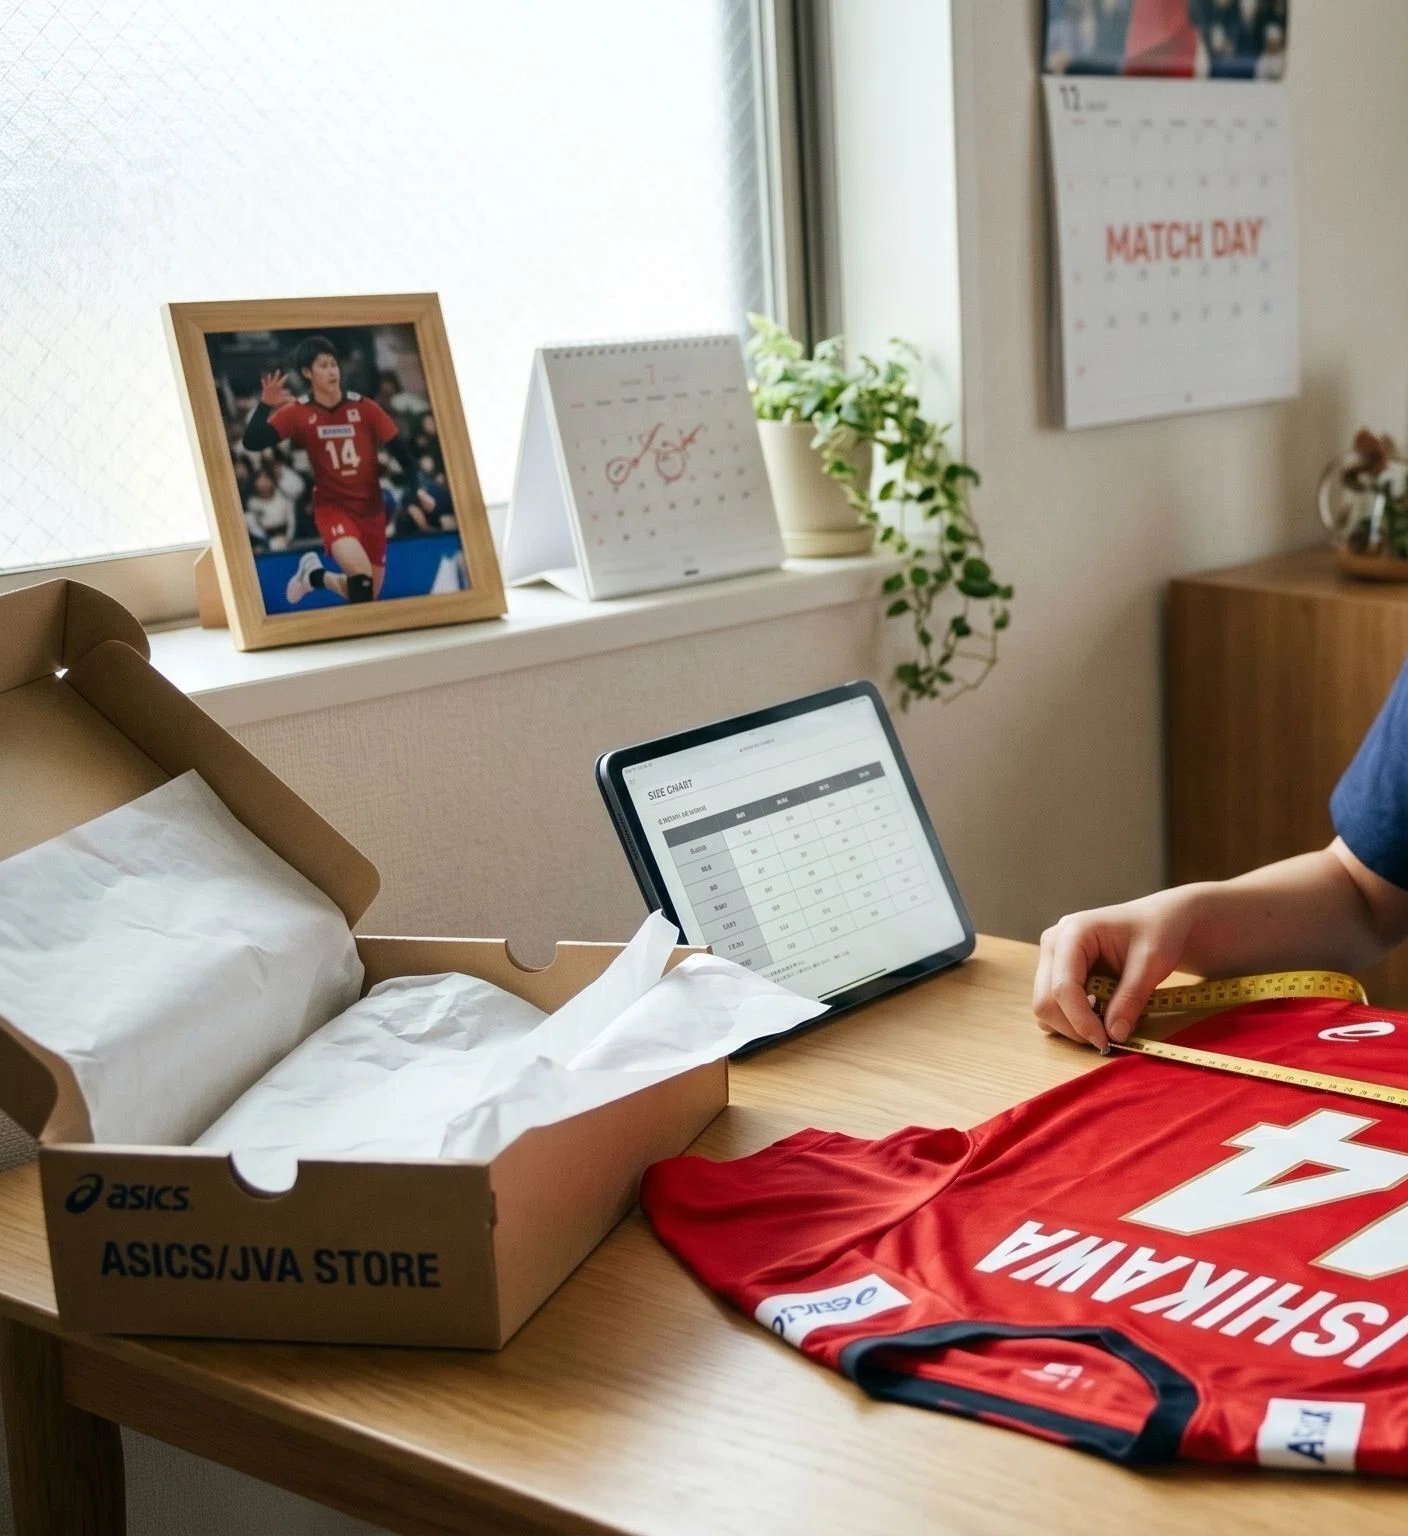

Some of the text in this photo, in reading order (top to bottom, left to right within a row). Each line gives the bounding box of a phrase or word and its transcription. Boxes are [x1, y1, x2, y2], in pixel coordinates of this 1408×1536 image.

[1105, 218, 1264, 264] MATCH DAY
[325, 438, 361, 469] 14
[106, 1183, 191, 1212] asics
[101, 1241, 442, 1289] ASICS/JVA STORE
